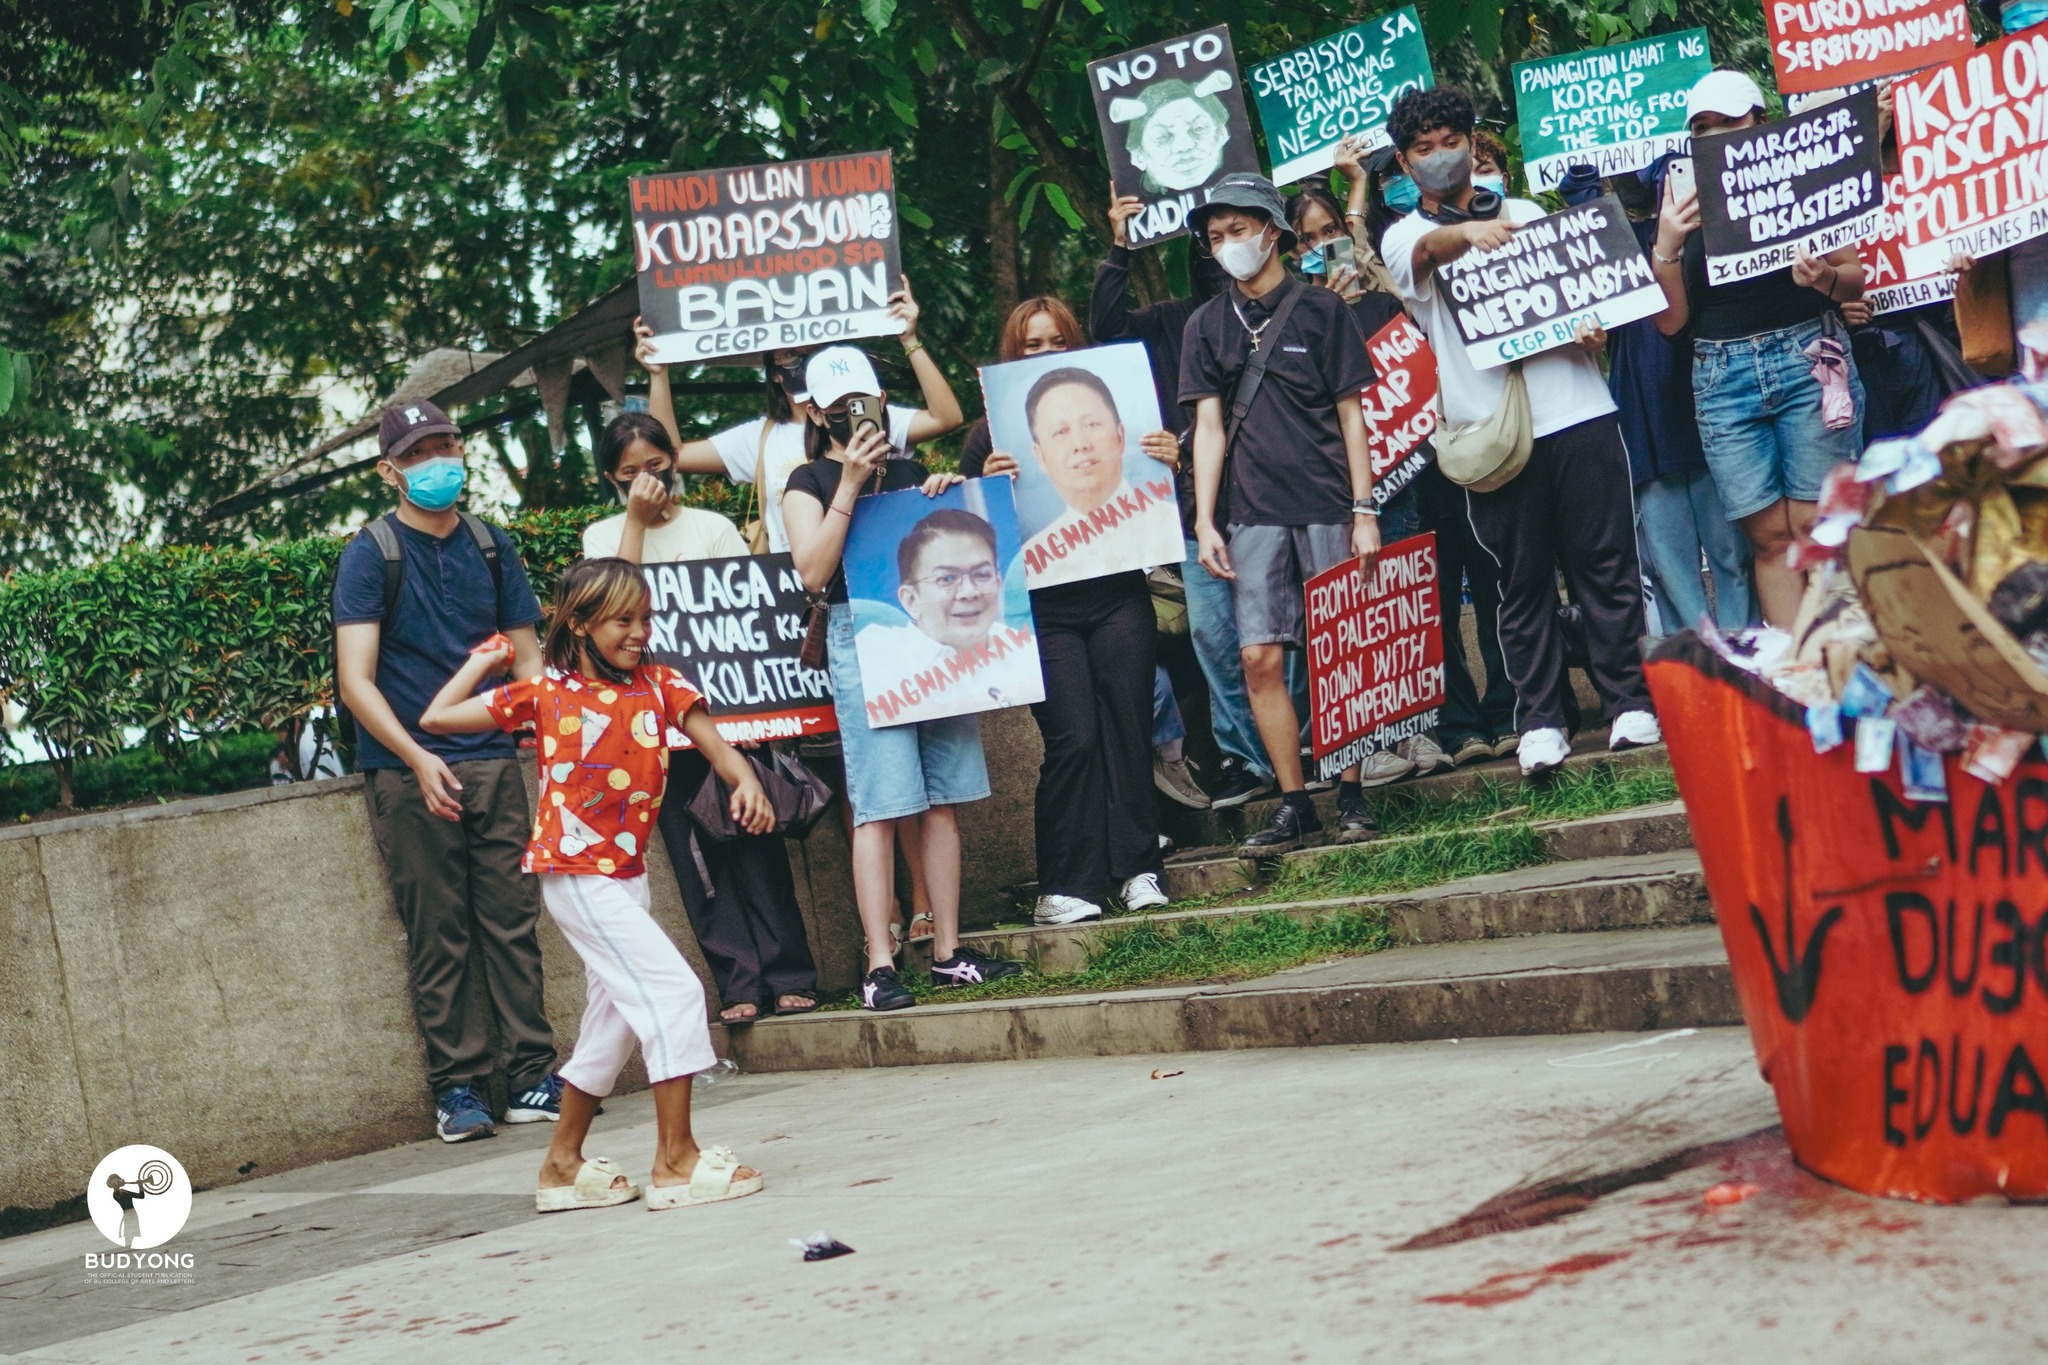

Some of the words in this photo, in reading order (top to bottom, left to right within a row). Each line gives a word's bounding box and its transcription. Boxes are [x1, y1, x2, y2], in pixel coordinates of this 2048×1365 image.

[1097, 54, 1158, 92] NO
[1164, 34, 1223, 69] TO
[1253, 32, 1365, 98] SERBISYO
[1381, 13, 1417, 46] SA
[1278, 86, 1322, 111] TAO,
[1327, 49, 1396, 89] HUWAG
[1520, 55, 1618, 93] PANAGUTIN
[1621, 42, 1666, 74] LAHAT
[1677, 35, 1705, 60] NG
[1296, 79, 1383, 127] GAWING
[1539, 98, 1643, 138] STARTING
[1648, 89, 1691, 114] FRO
[1551, 72, 1645, 114] KORAP
[1558, 131, 1600, 152] THE
[1605, 115, 1660, 143] TOP
[1725, 116, 1825, 169] MARCOS
[632, 174, 718, 213] HINDI
[728, 165, 804, 205] ULAN
[810, 154, 891, 199] KUNDI
[1726, 181, 1796, 221] KING
[1750, 170, 1872, 242] DISASTER!
[633, 194, 871, 273] KURAPSYON
[1560, 207, 1608, 241] ANG
[1735, 238, 1818, 273] GABRIEA
[1821, 213, 1878, 250] PARTYLIST
[655, 250, 838, 289] LUMULUNOD
[843, 240, 886, 265] SA
[1451, 249, 1568, 303] ORIGINAL
[1566, 234, 1607, 270] NA
[678, 262, 889, 331] BAYAN
[1457, 283, 1558, 341] NEPO
[1559, 252, 1655, 311] BABY-M
[1870, 283, 1932, 313] ABRIELA
[695, 326, 769, 354] CEGP
[780, 318, 859, 344] BICOL
[1372, 321, 1426, 373] MGA
[1498, 329, 1548, 361] CEGP
[1361, 369, 1411, 432] RAP
[1370, 393, 1441, 476] RAKOT
[1371, 451, 1427, 505] BATAAN
[1022, 476, 1173, 577] MAGNANAKAW
[1310, 574, 1349, 631] FROM
[1311, 631, 1333, 669] TO
[1337, 586, 1440, 658] PALESTINE,
[648, 611, 691, 657] AY,
[689, 612, 769, 653] WAG
[866, 623, 1032, 724] MAGNANAKAW
[1318, 653, 1363, 714] DOWN
[1372, 630, 1427, 704] WITH
[1319, 706, 1342, 745] US
[1345, 661, 1445, 733] IMPERIALISM
